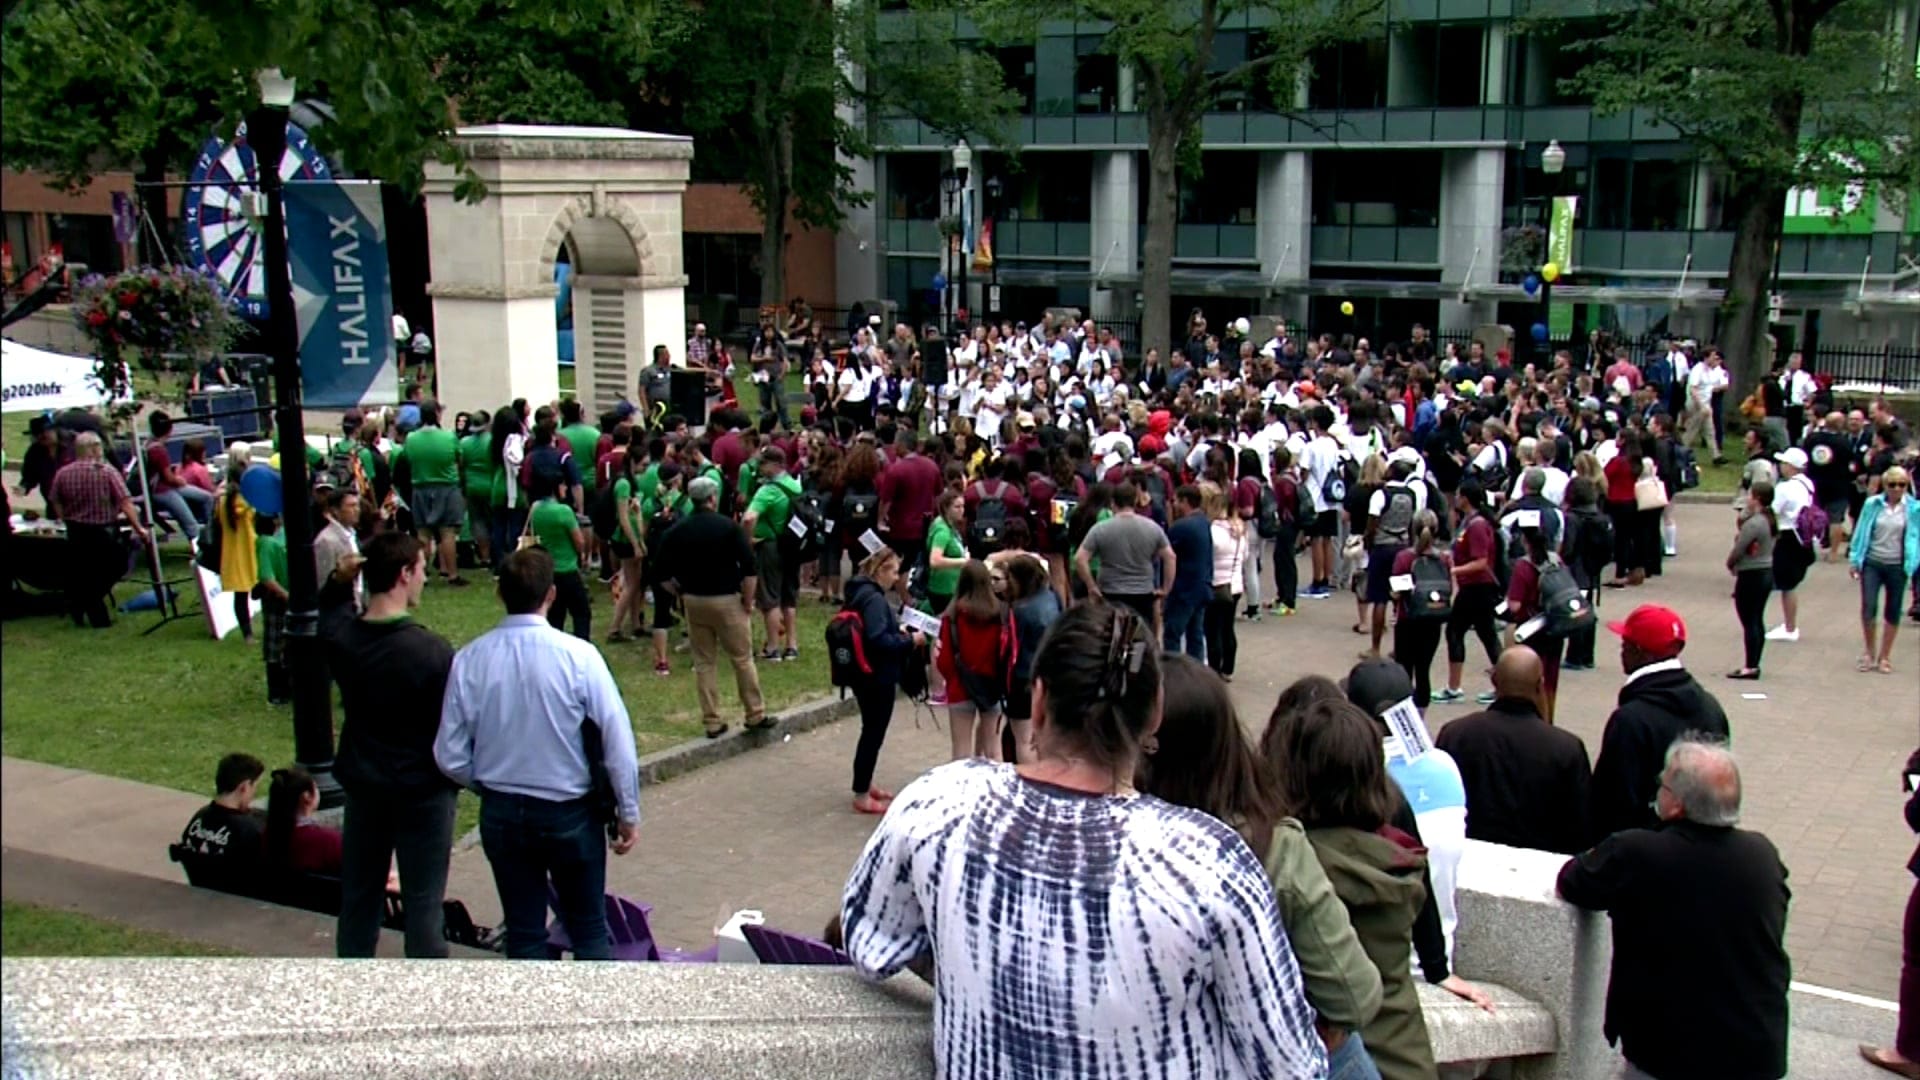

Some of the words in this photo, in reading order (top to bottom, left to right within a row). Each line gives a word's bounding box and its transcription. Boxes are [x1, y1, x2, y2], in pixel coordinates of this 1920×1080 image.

[187, 206, 198, 223] 14
[328, 214, 370, 365] HALIFAX
[247, 302, 261, 315] 19
